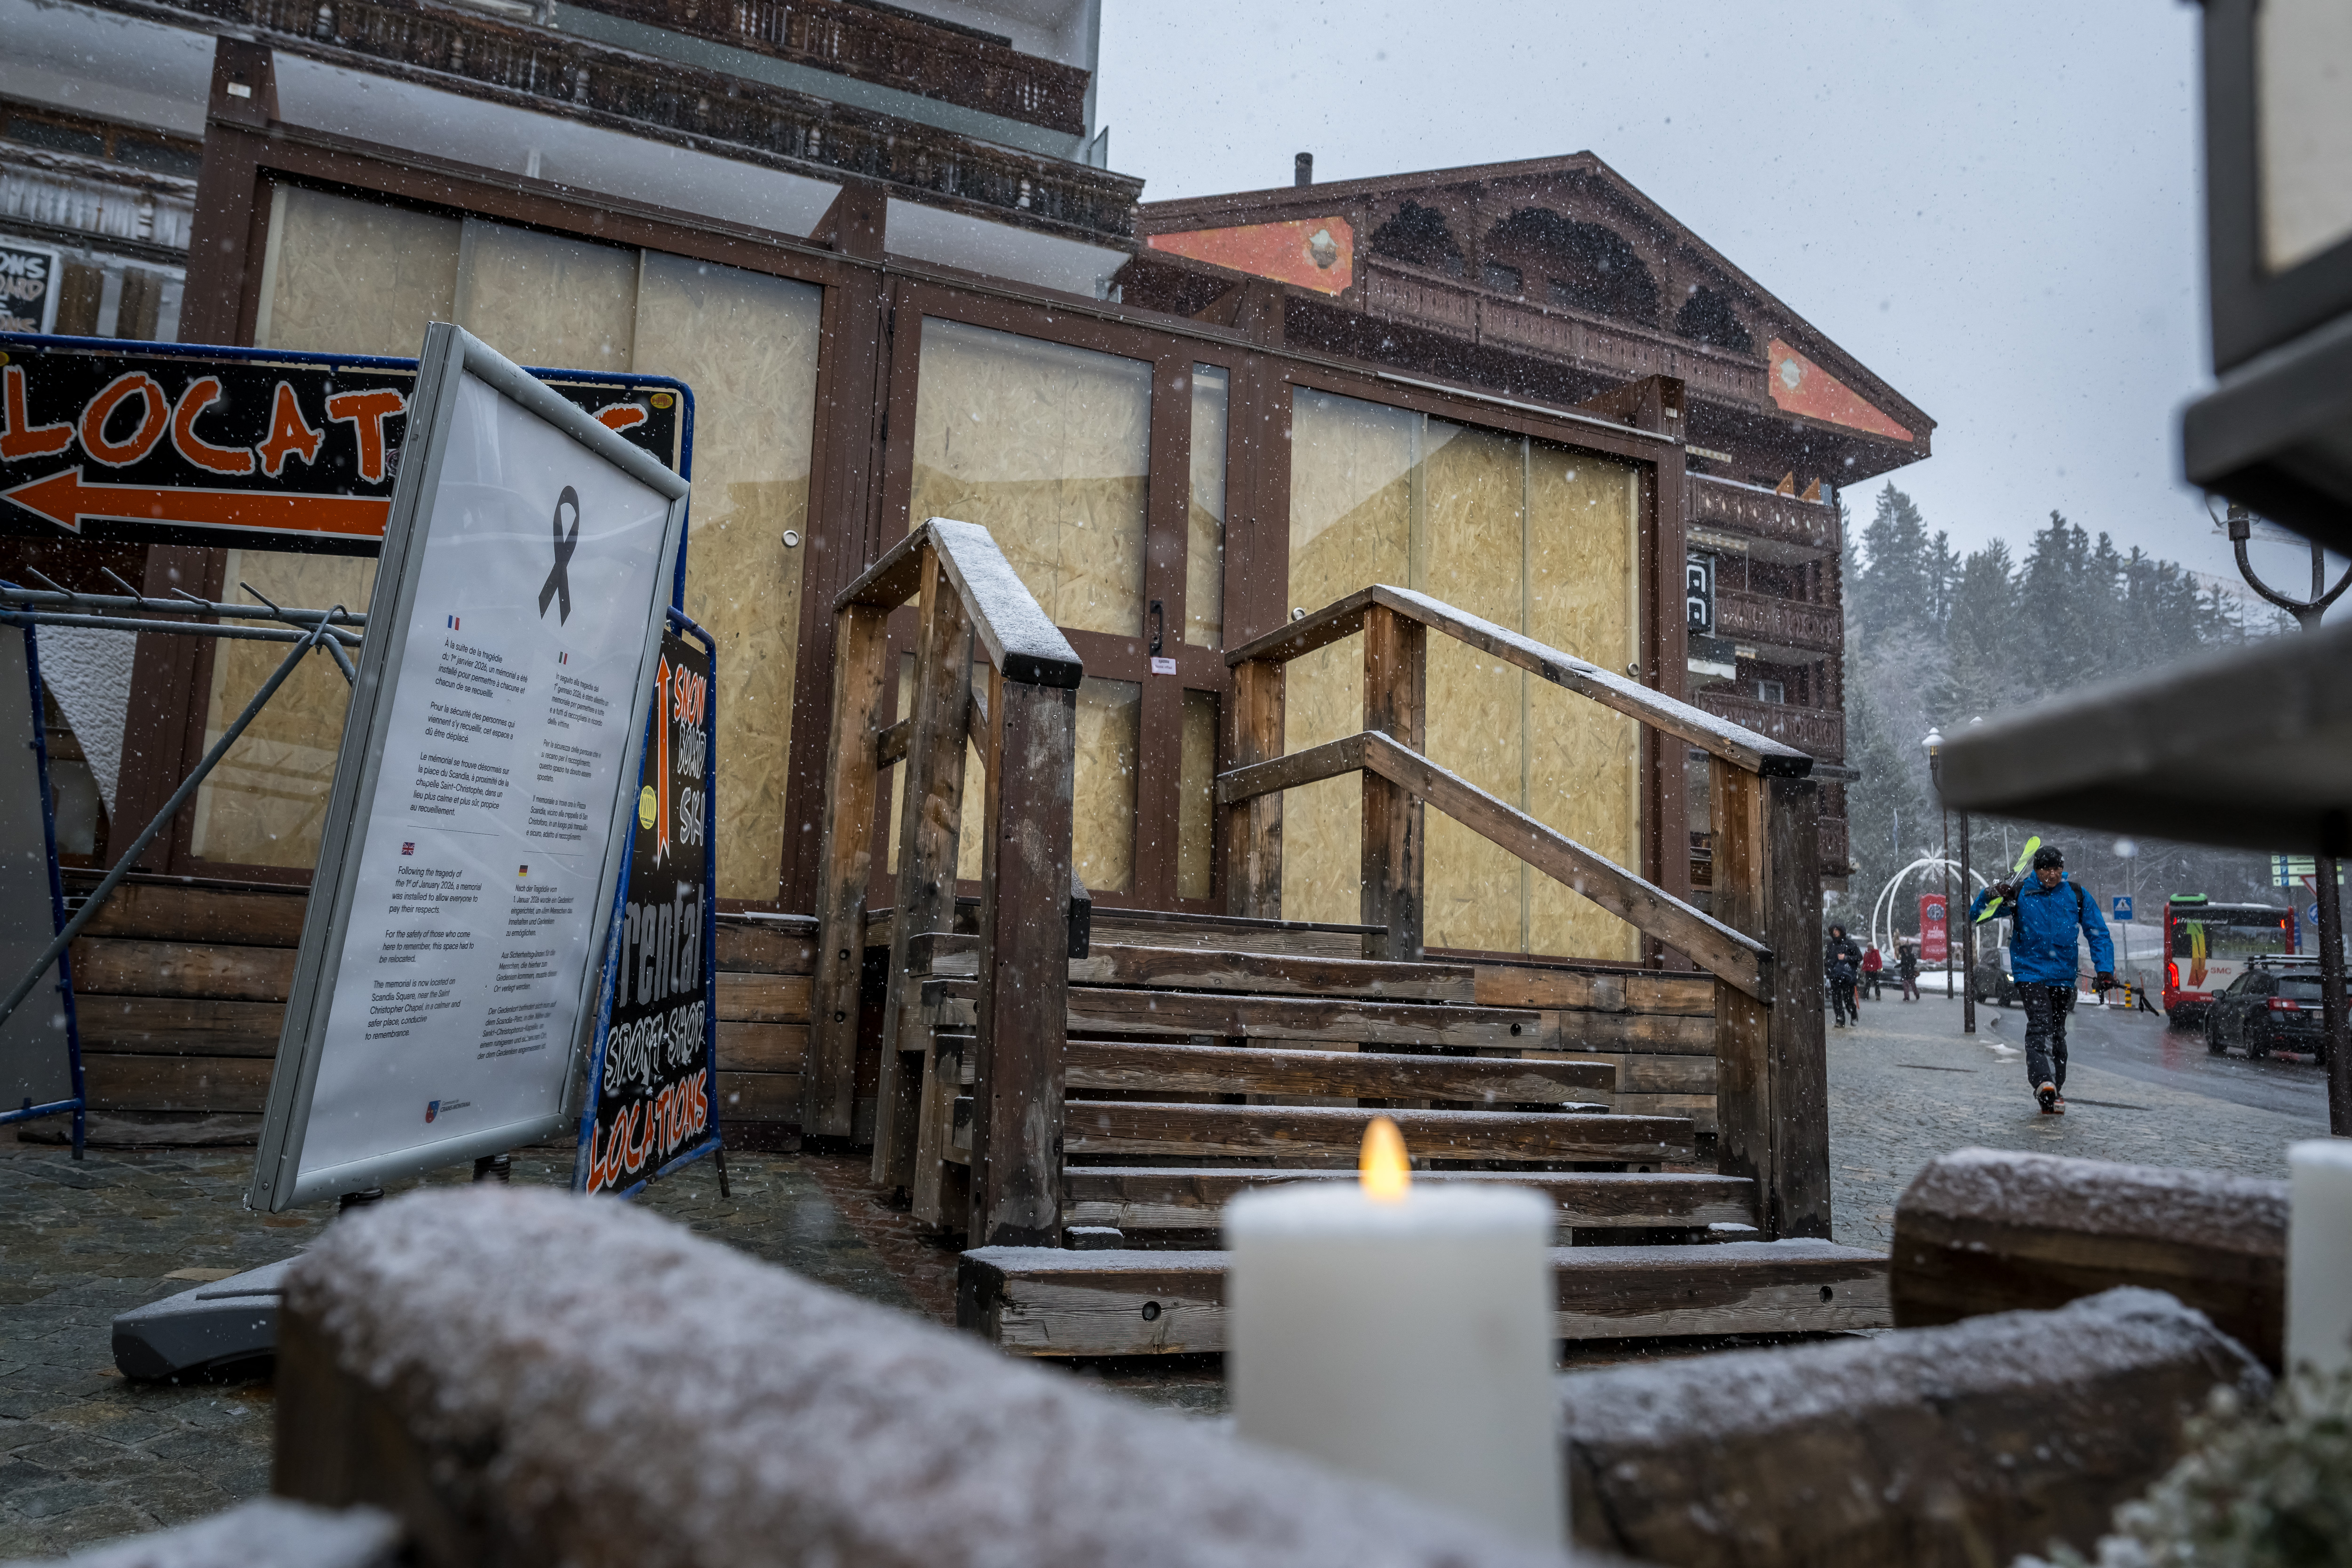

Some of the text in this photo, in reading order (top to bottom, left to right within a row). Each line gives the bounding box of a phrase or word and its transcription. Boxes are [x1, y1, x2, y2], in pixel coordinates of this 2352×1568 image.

[0, 365, 648, 486] LOCAT
[445, 637, 502, 663] À la suite de la tragédie
[442, 652, 449, 661] du
[456, 657, 474, 668] janvier
[474, 661, 487, 673] 2026,
[495, 668, 516, 680] mémorial
[435, 677, 455, 688] chacun
[471, 687, 493, 698] recueillir.
[438, 664, 457, 676] installé
[457, 671, 471, 679] pour
[471, 675, 496, 686] permettre
[500, 682, 519, 692] chacune
[580, 680, 593, 690] tragedia
[674, 663, 707, 725] SNOW
[430, 701, 444, 711] Pour
[444, 704, 449, 713] la
[450, 707, 471, 718] sécurité
[472, 711, 482, 720] des
[482, 715, 507, 726] personnes
[428, 715, 451, 726] viennent
[460, 723, 482, 734] recueillir,
[492, 730, 509, 739] espace
[434, 729, 445, 738] être
[446, 732, 469, 743] déplacé.
[554, 742, 570, 752] sicurezza
[677, 721, 706, 779] BOARD
[420, 751, 427, 760] Le
[428, 754, 453, 765] mémorial
[461, 760, 477, 769] trouve
[477, 763, 501, 774] désormais
[418, 764, 423, 772] la
[424, 766, 439, 775] place
[449, 770, 470, 782] Scandia,
[475, 775, 497, 785] proximité
[416, 778, 439, 788] chapelle
[440, 781, 484, 796] Saint-Christophe,
[485, 788, 496, 797] dans
[413, 789, 424, 799] lieu
[424, 792, 436, 801] plus
[437, 794, 453, 803] calme
[471, 799, 480, 807] sûr,
[480, 801, 500, 810] propice
[418, 805, 455, 816] recueillement.
[680, 787, 706, 846] SKI
[398, 866, 424, 877] Following
[435, 869, 455, 879] tragedy
[419, 880, 440, 891] January
[440, 881, 455, 891] 2026,
[404, 892, 428, 900] installed
[389, 905, 400, 914] pay
[415, 906, 440, 915] respects.
[385, 930, 395, 938] For
[406, 930, 423, 939] safety
[619, 880, 704, 1007] rental
[382, 942, 396, 951] here
[403, 942, 431, 951] remember,
[443, 943, 459, 951] space
[373, 980, 384, 988] The
[385, 979, 412, 988] memorial
[429, 978, 449, 986] located
[372, 992, 395, 1002] Scandia
[396, 992, 416, 1002] Square,
[370, 1005, 404, 1015] Christopher
[405, 1003, 424, 1013] Chapel,
[368, 1015, 428, 1028] safer place, conducive
[372, 1030, 410, 1040] remembrance.
[604, 1000, 706, 1091] SPORT SHOP
[586, 1067, 708, 1198] LOCATIONS
